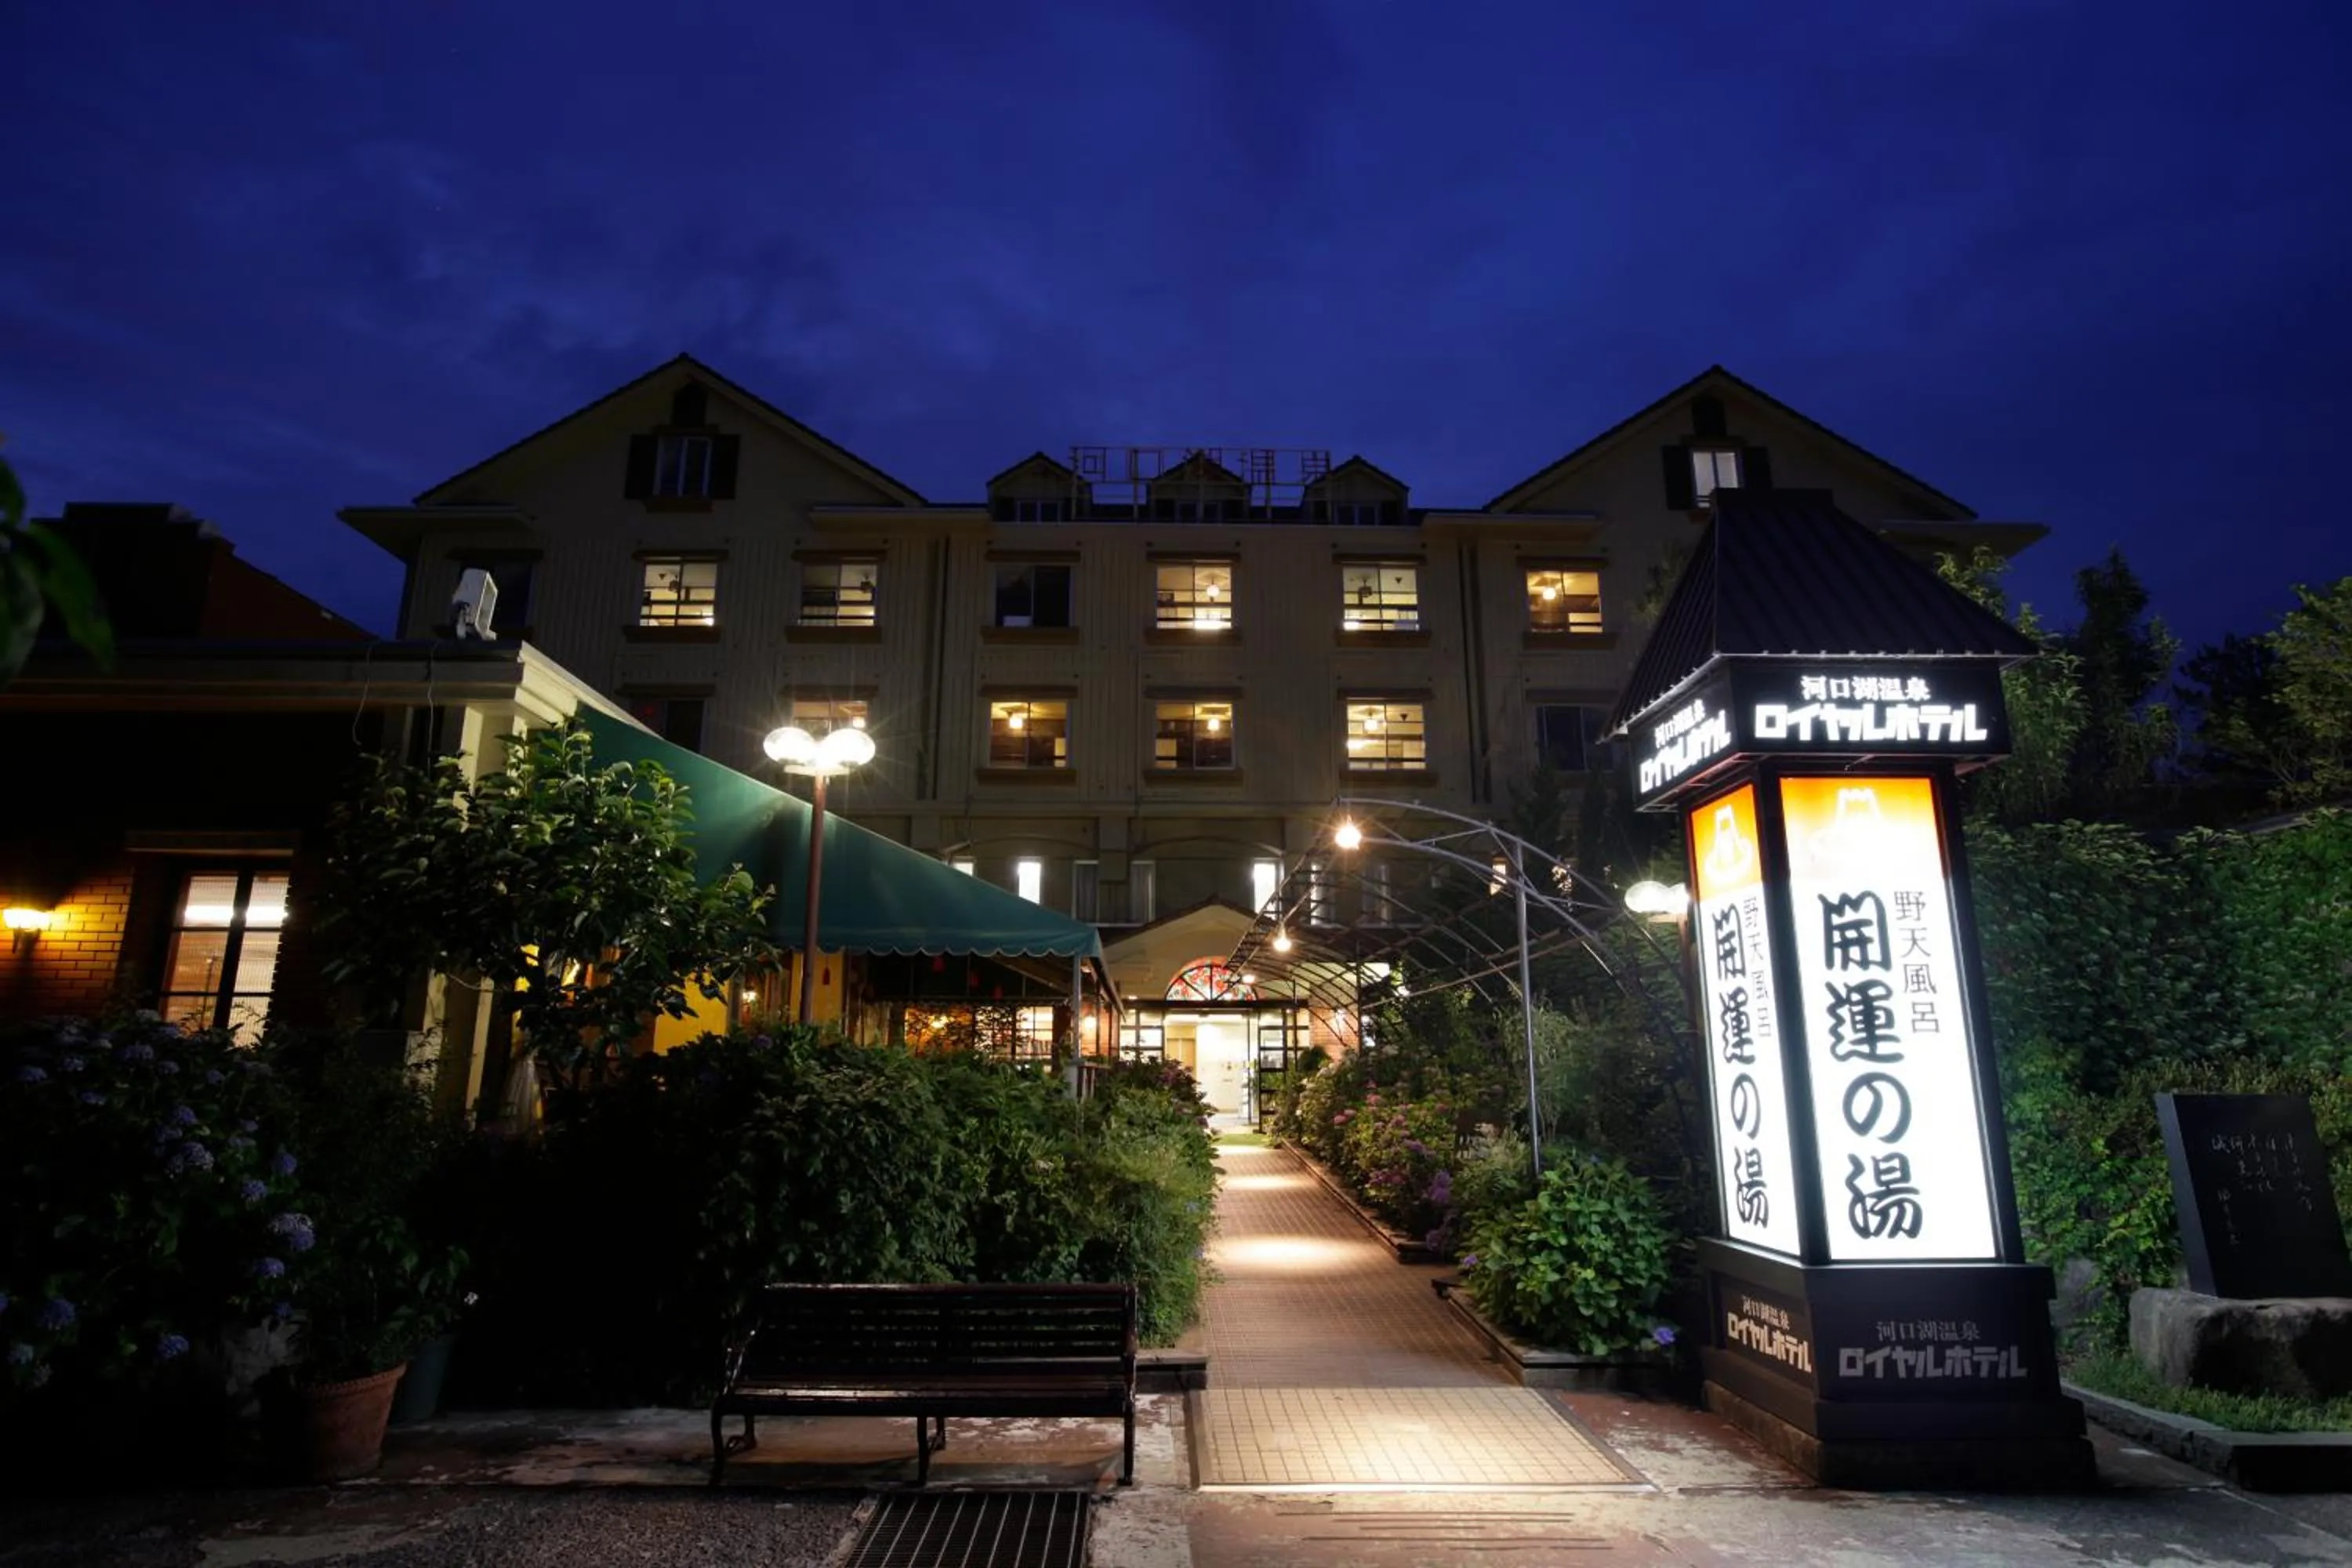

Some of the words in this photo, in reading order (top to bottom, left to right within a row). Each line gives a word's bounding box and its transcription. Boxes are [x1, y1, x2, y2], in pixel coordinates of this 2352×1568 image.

[1801, 676, 1931, 701] 河口湖温泉
[1755, 703, 1987, 742] ロイヤルホテル
[1639, 707, 1732, 794] ロイヤルホテル
[1893, 890, 1940, 1034] 野天風呂
[1712, 902, 1769, 1229] 開運の湯
[1818, 890, 1923, 1240] 開運の湯
[1740, 1294, 1791, 1331] 河口湖温泉
[1876, 1319, 1981, 1343] 河口湖温泉
[1726, 1311, 1813, 1374] ロイヤルホテル
[1838, 1345, 2029, 1379] ロイヤルホテル
